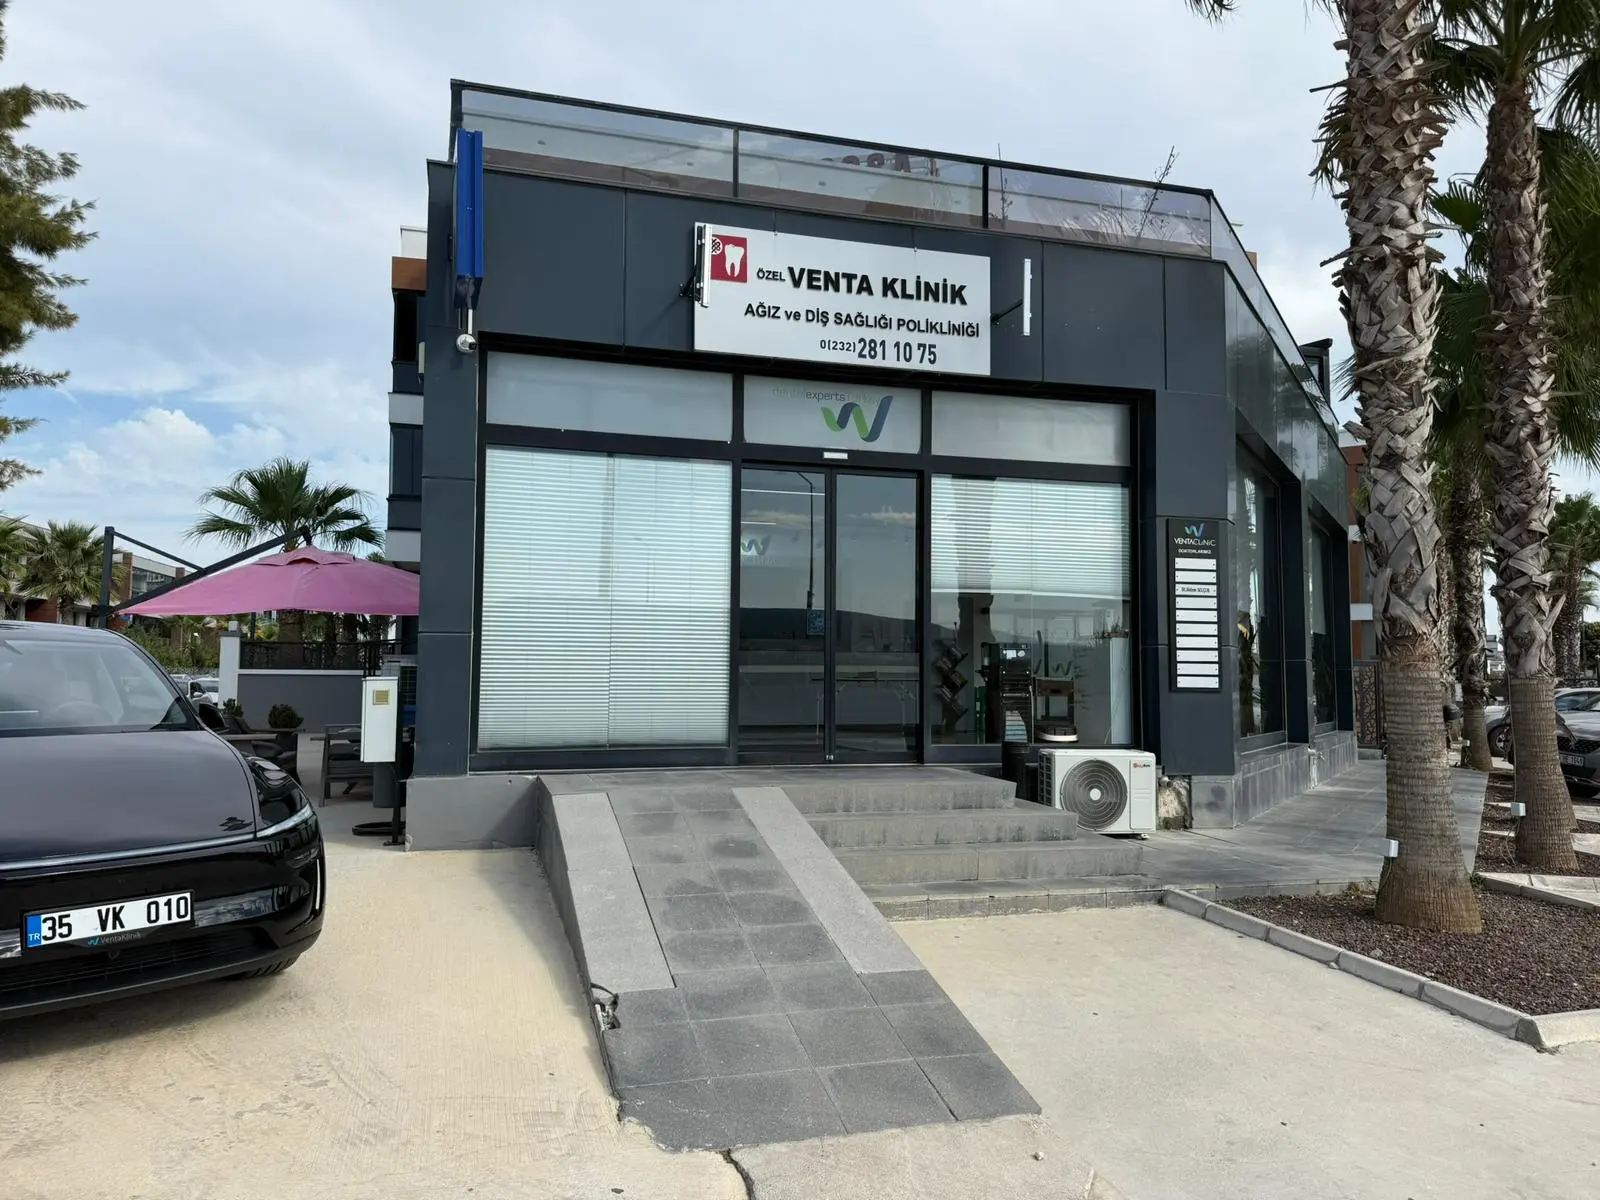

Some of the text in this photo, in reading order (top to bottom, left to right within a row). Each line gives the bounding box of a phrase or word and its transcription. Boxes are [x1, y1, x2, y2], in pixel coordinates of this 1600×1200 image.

[757, 266, 967, 305] ÖZEL VENTA KLİNİK
[744, 301, 979, 338] AĞIZ ve DİŞ SAĞLIĞI POLİKLİNİĞİ
[820, 337, 937, 365] 0(232) 281 10 75
[28, 933, 41, 942] TR
[42, 896, 189, 942] 35 VK 010
